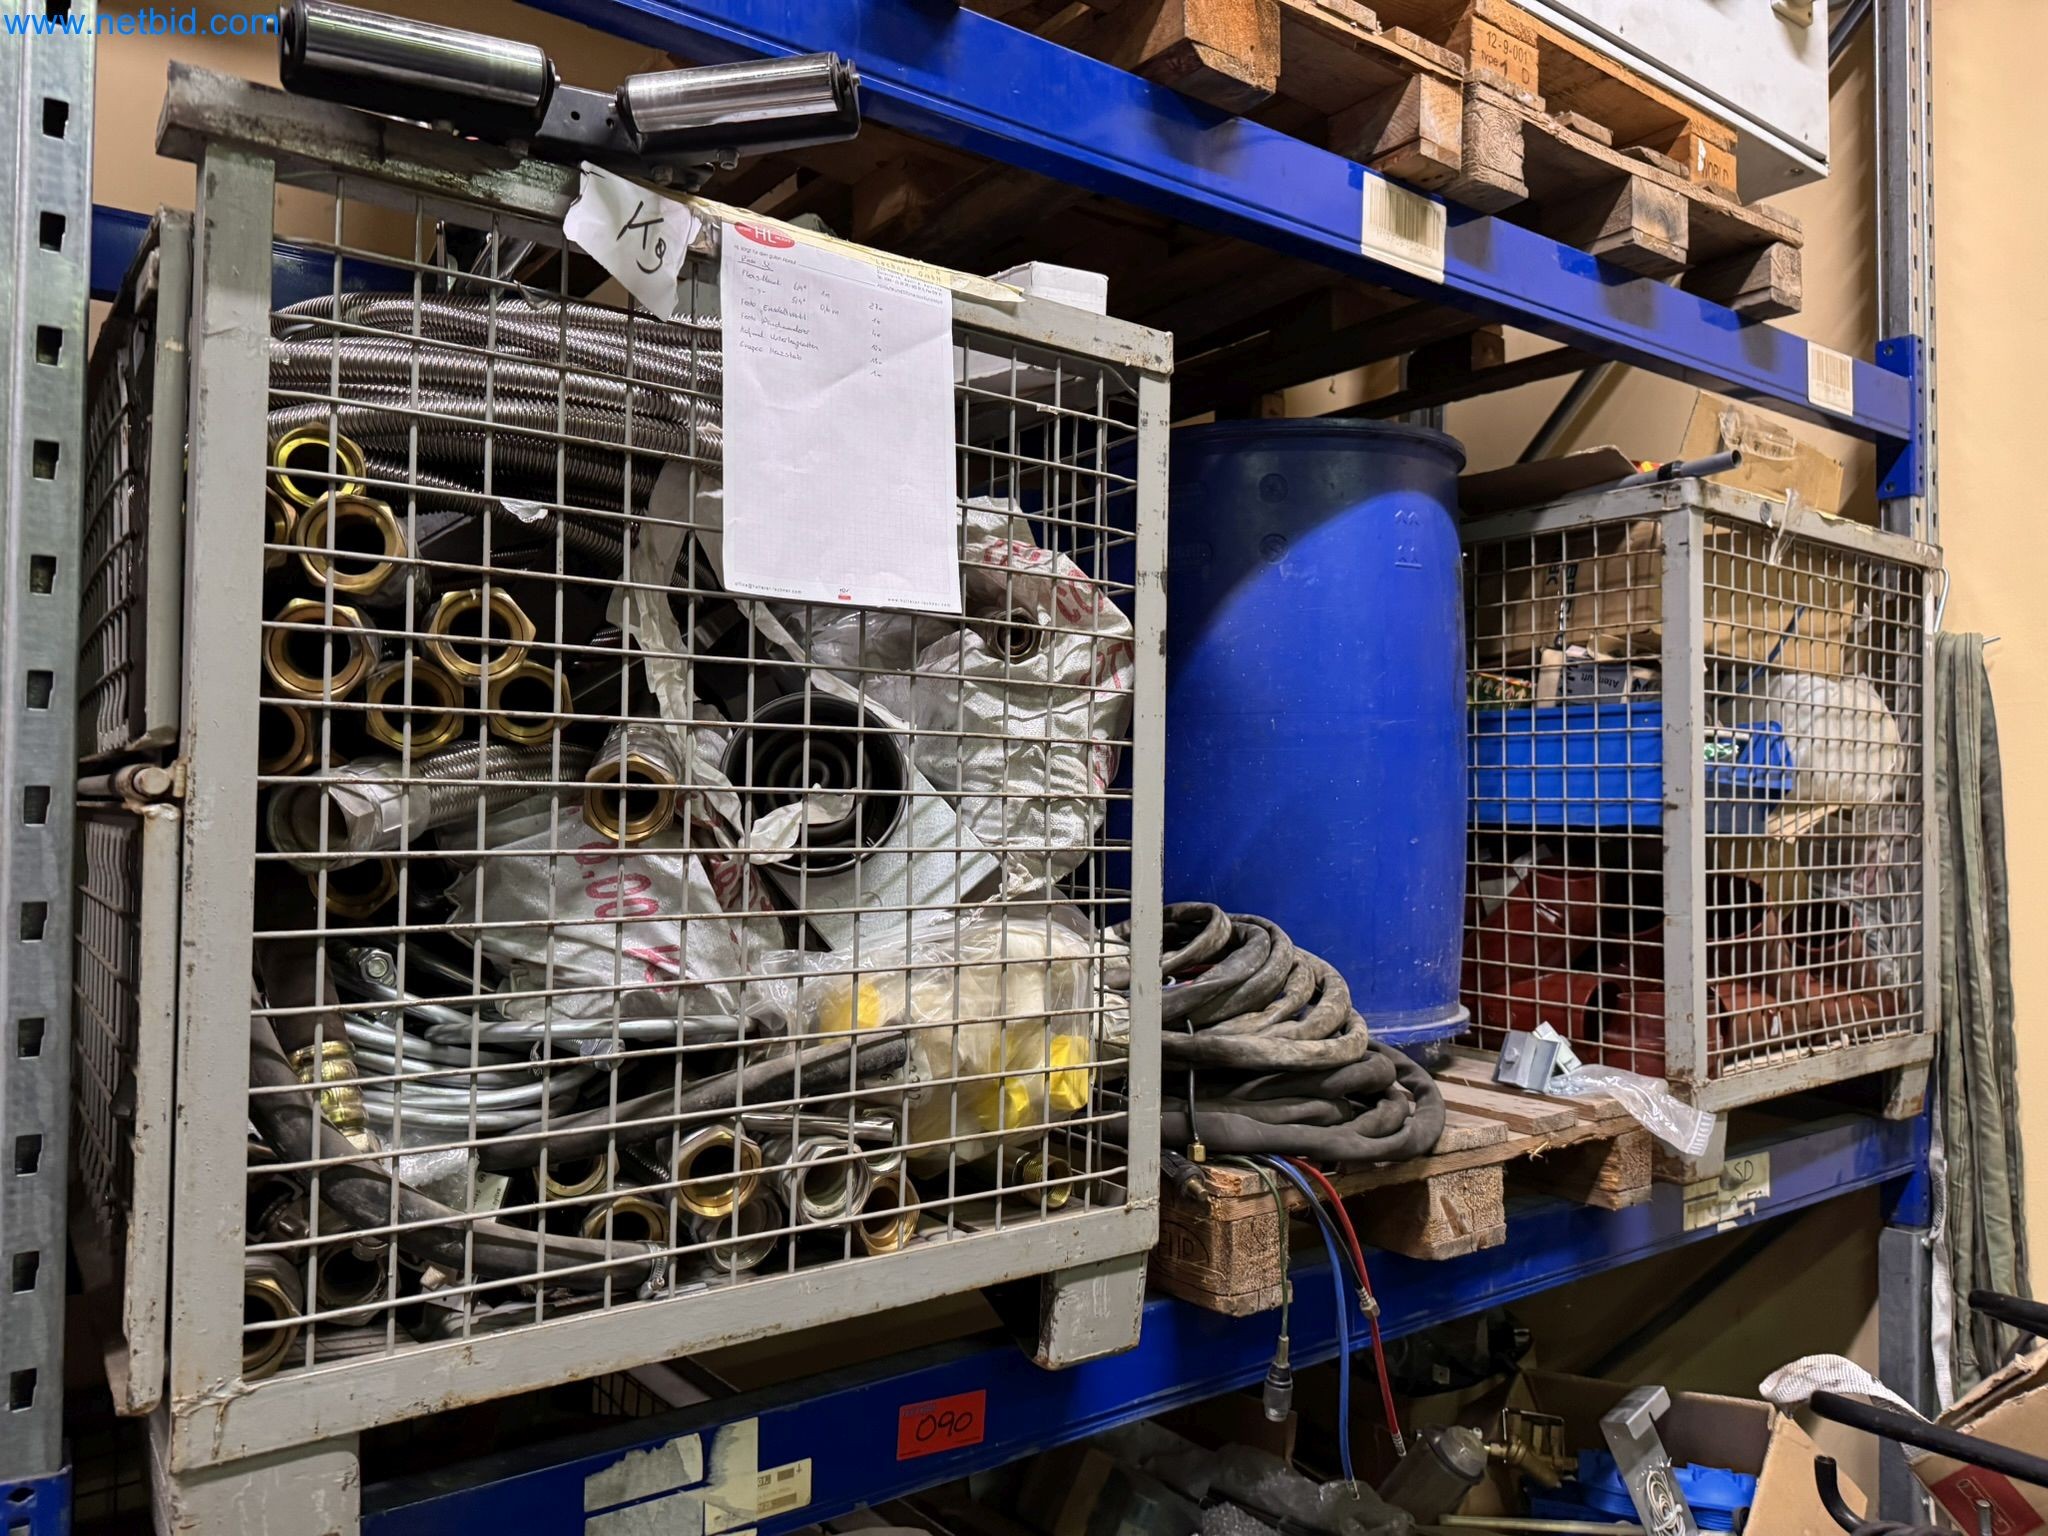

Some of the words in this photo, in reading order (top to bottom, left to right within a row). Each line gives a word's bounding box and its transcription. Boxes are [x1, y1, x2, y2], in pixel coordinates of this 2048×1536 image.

[1500, 60, 1508, 77] 1
[754, 226, 777, 244] HL
[915, 1410, 974, 1442] 090
